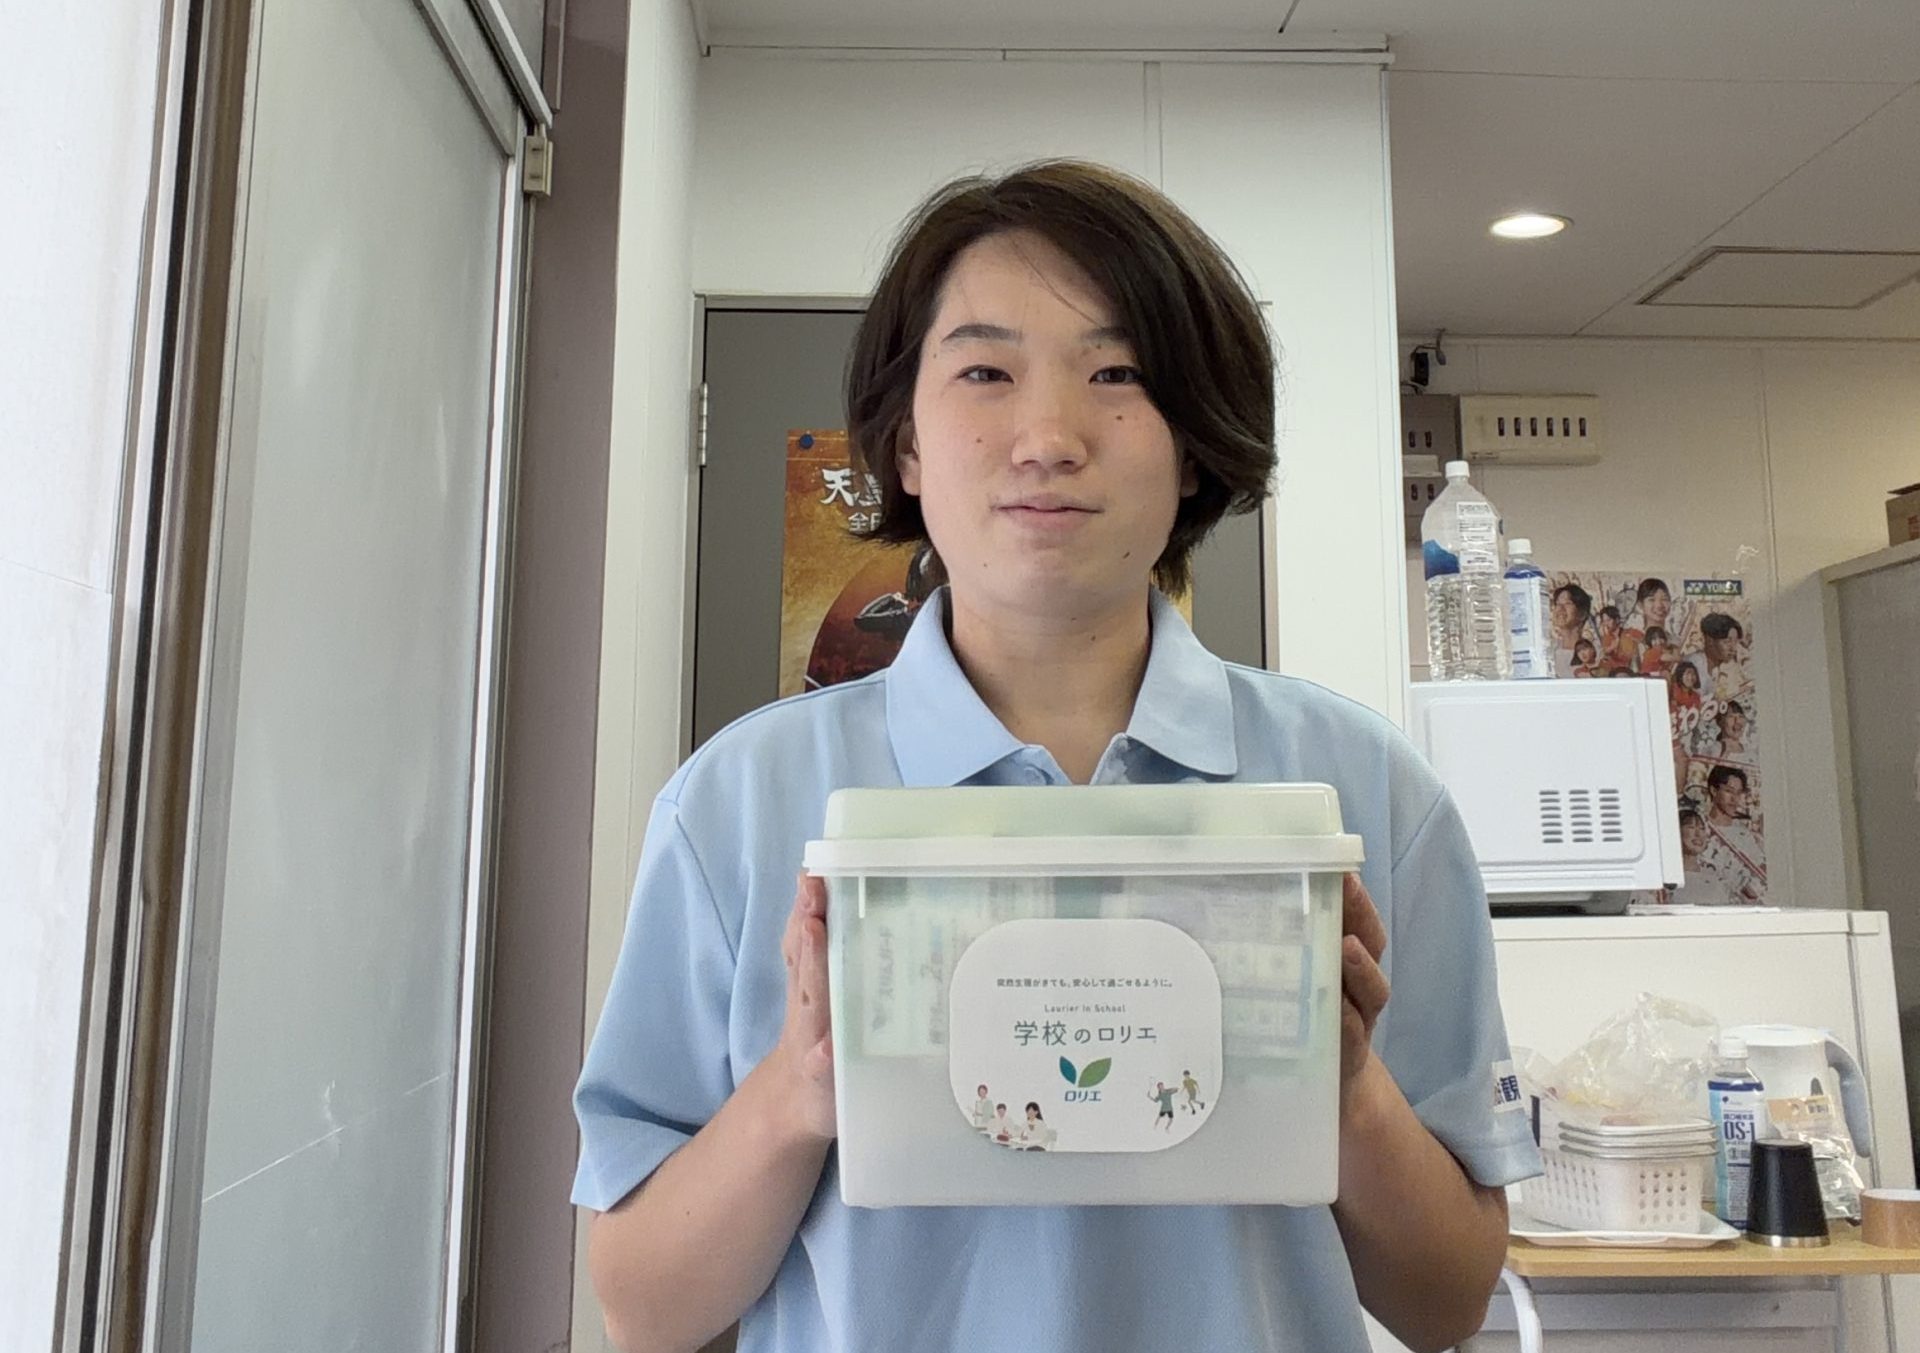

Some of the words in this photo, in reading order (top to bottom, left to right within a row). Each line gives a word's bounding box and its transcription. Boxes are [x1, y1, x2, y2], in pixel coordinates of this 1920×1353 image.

[1044, 1003, 1079, 1013] Laurier
[1014, 1020, 1157, 1046] 学校のロリエ
[1064, 1090, 1102, 1103] ロリエ
